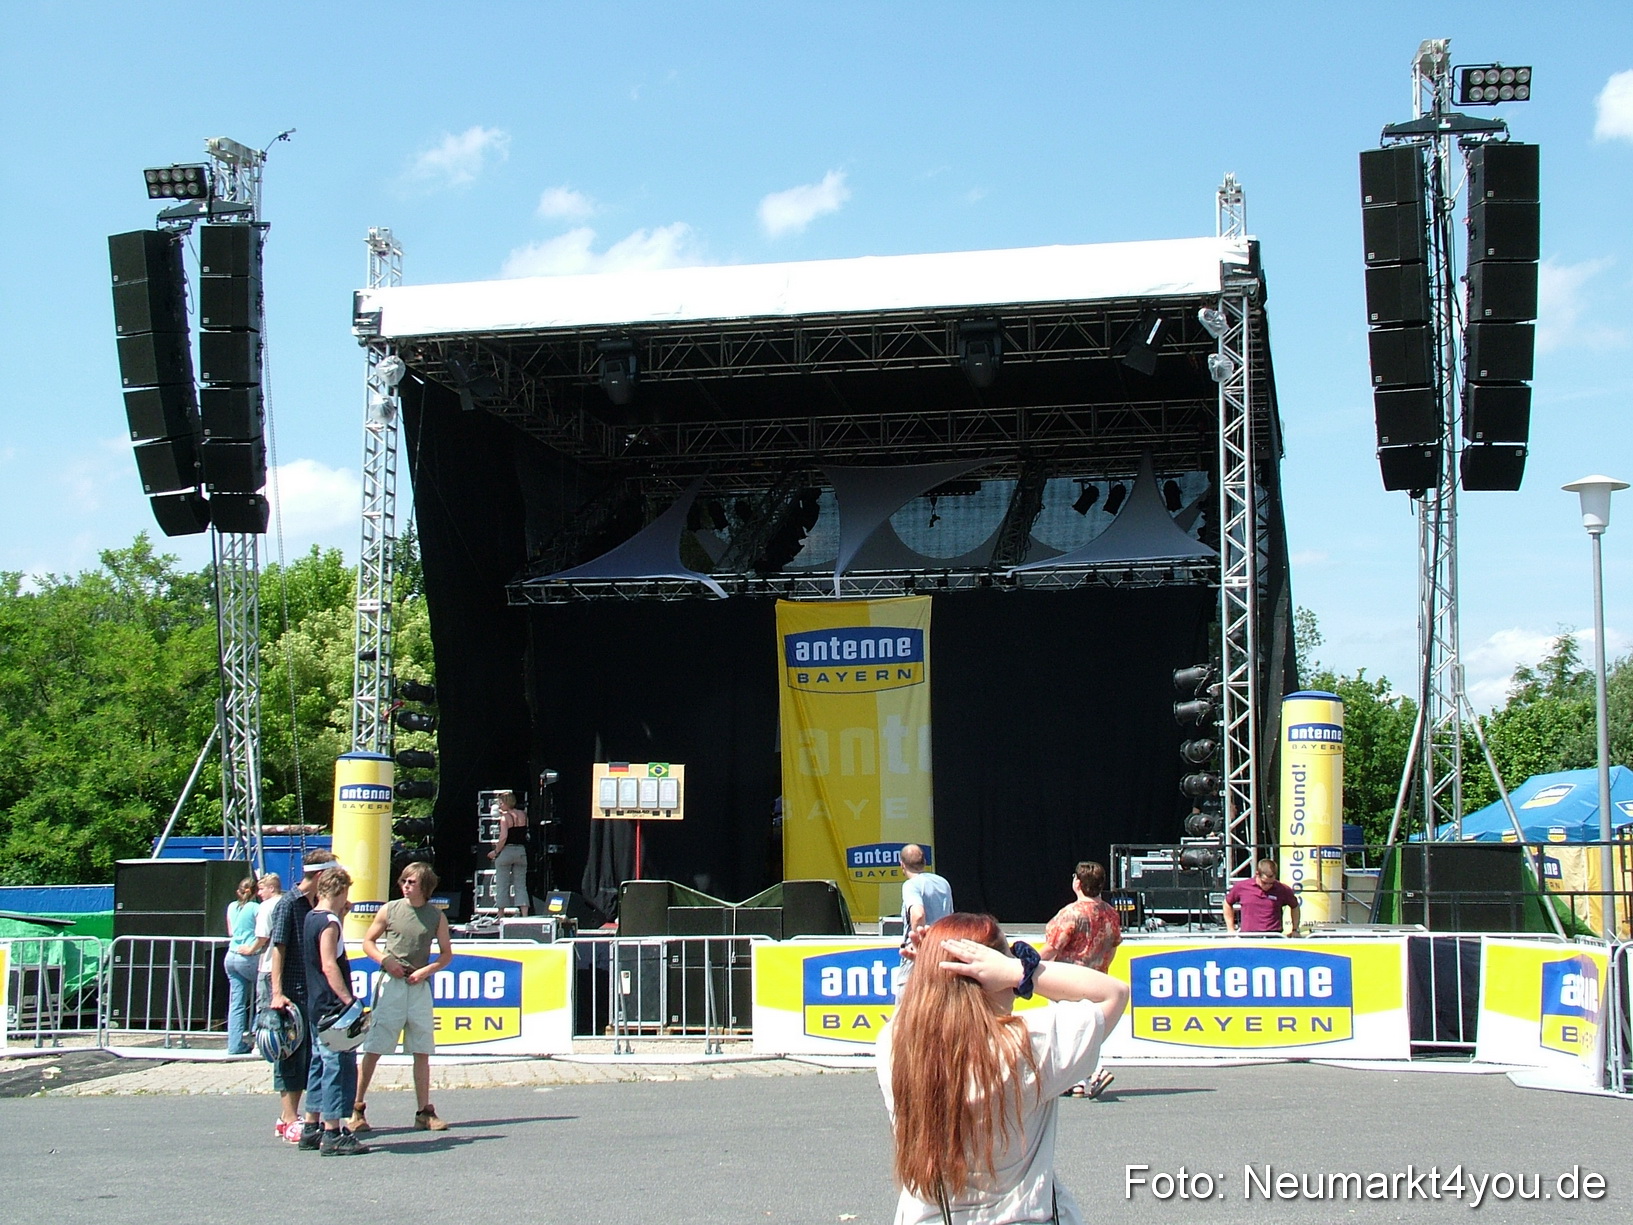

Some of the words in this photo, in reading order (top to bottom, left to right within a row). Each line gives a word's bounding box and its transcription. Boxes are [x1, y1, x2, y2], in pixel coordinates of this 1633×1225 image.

[795, 636, 911, 661] antenne
[797, 668, 912, 684] BAYERN
[1291, 726, 1342, 740] antenne
[1292, 743, 1342, 751] BAYERN
[341, 787, 390, 800] antenne
[1290, 764, 1306, 837] Sound!
[783, 797, 934, 821] AYE
[854, 848, 901, 864] anten
[855, 869, 899, 878] BAYE
[1150, 960, 1333, 998] antenne
[1152, 1016, 1333, 1032] BAYERN
